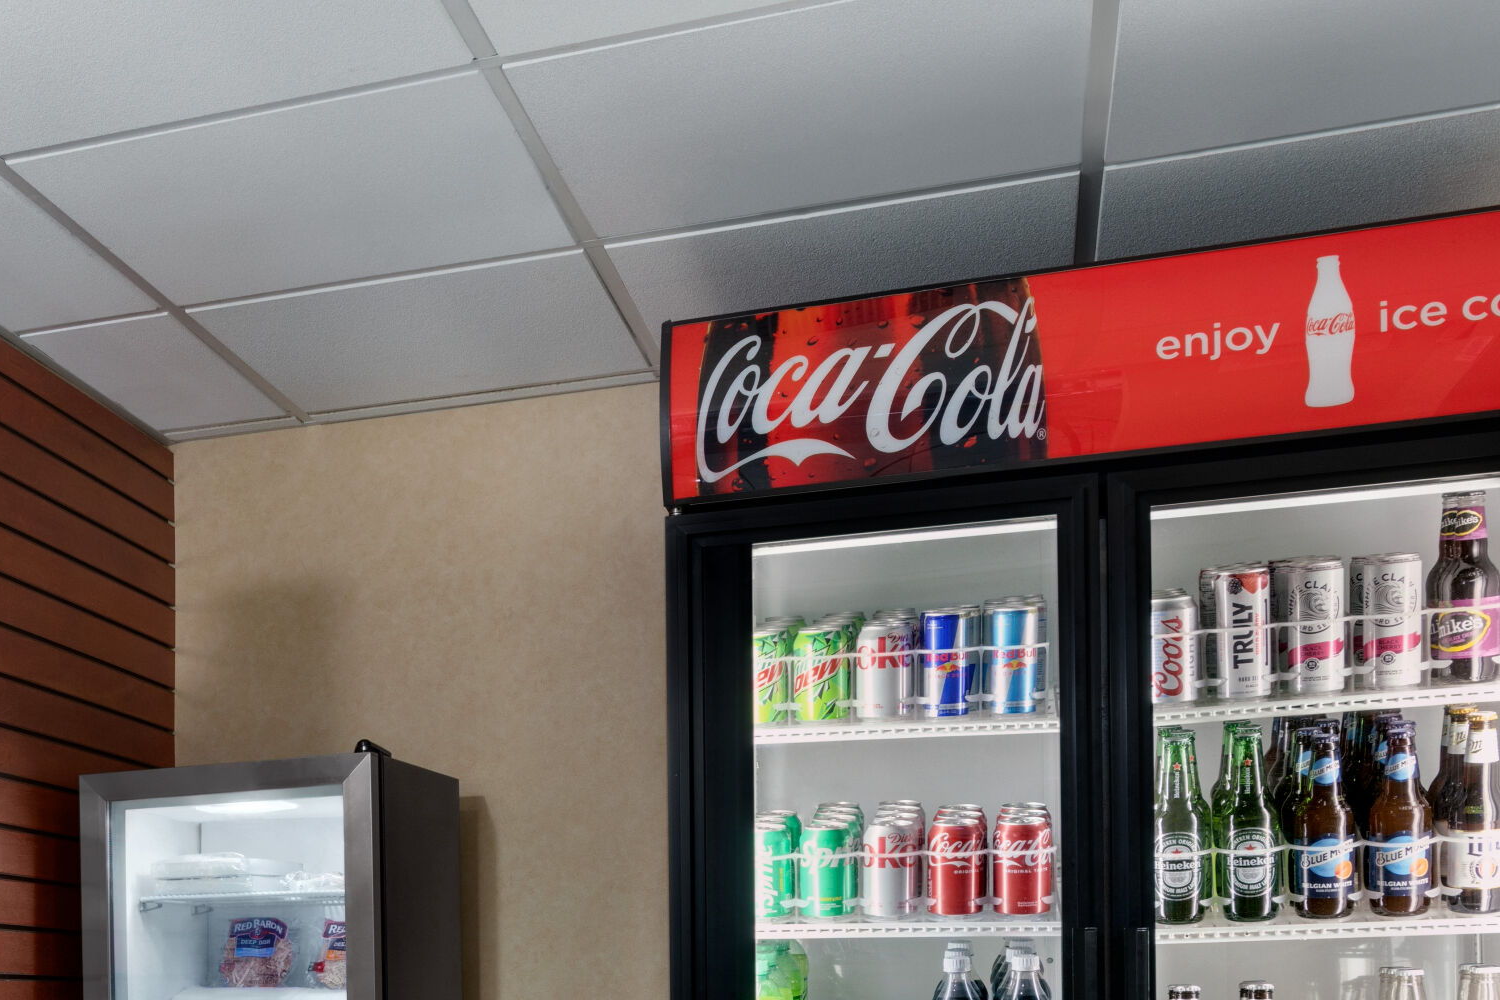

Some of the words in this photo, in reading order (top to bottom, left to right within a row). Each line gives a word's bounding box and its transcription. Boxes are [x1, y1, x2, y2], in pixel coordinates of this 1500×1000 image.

[1307, 312, 1356, 337] Coca-Cola
[1379, 300, 1447, 333] ice
[1156, 322, 1281, 361] enjoy
[699, 298, 1044, 485] Coca-Cola
[1232, 602, 1254, 670] TRULY
[1151, 614, 1183, 699] Coors
[863, 836, 918, 869] oke
[1154, 858, 1202, 871] Heineken
[1227, 855, 1275, 867] Heineken
[1301, 852, 1328, 869] BLUE
[1376, 850, 1403, 867] BLUE
[234, 921, 252, 934] RED
[253, 919, 283, 934] BARON
